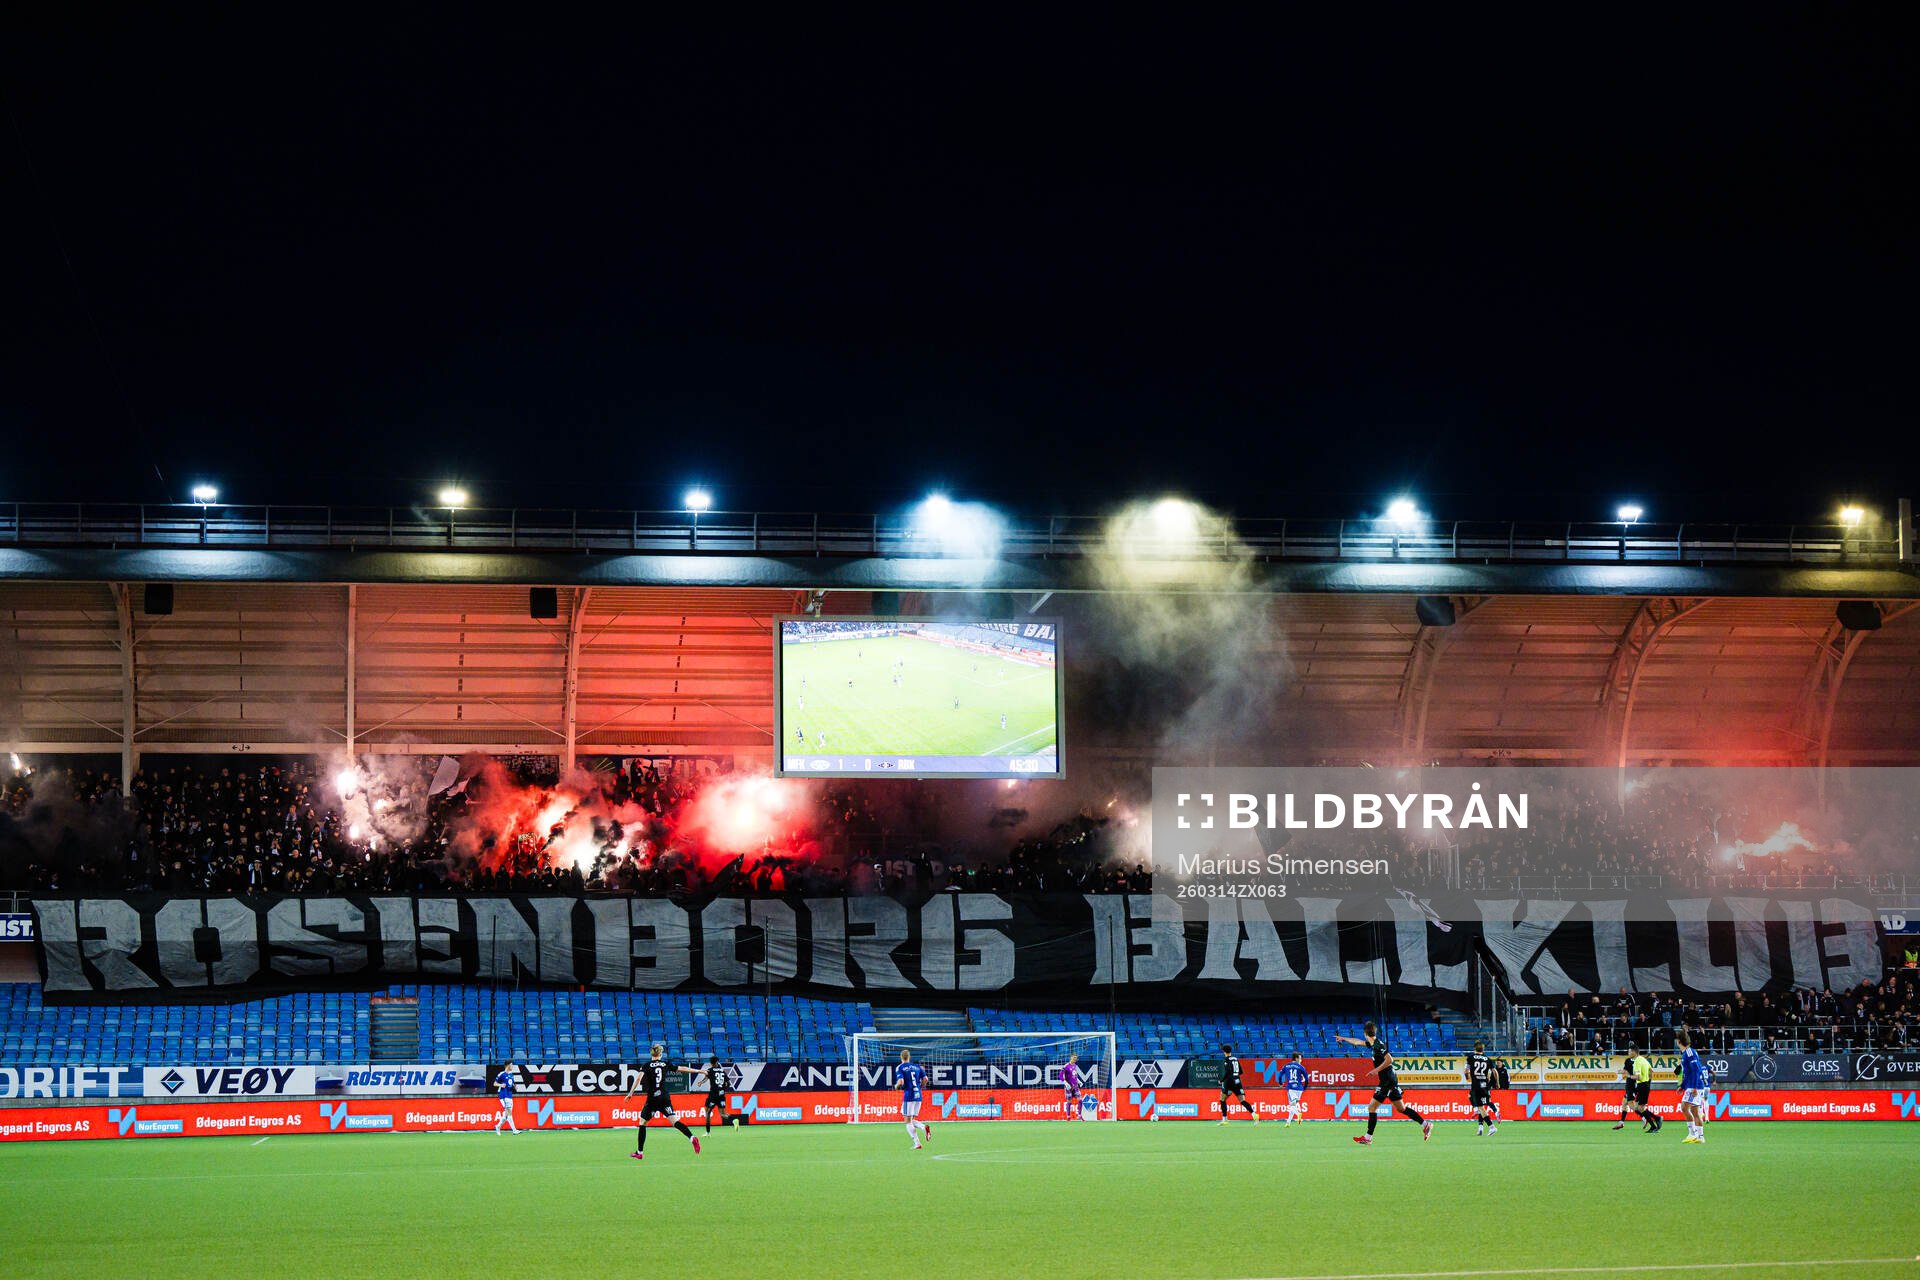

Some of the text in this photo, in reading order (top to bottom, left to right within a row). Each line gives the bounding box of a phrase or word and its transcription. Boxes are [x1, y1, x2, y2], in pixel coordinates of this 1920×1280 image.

[32, 894, 1016, 991] ROSENBORG
[1392, 1059, 1456, 1071] SMART
[1474, 1061, 1488, 1076] 22
[1548, 1058, 1612, 1070] SMART
[1802, 1060, 1840, 1072] GLASS
[195, 1067, 295, 1095] VEØY
[346, 1070, 457, 1086] ROSTEIN AS
[655, 1067, 663, 1083] 3
[714, 1072, 725, 1085] 35
[1289, 1069, 1298, 1080] 14
[864, 1103, 898, 1116] Engros
[1014, 1102, 1060, 1114] Ødegaard
[1098, 1101, 1112, 1112] AS
[1157, 1105, 1195, 1115] NorEngros
[1543, 1106, 1580, 1115] NorEngros
[1732, 1106, 1768, 1115] NorEngros
[1783, 1102, 1876, 1115] Ødegaard Engros AS
[406, 1111, 455, 1124] Ødegaard
[458, 1111, 492, 1124] Engros
[556, 1114, 596, 1123] NorEngros
[759, 1110, 798, 1119] NorEngros
[36, 1121, 71, 1134] Engros
[75, 1120, 90, 1132] AS
[138, 1122, 180, 1132] NorEngros
[196, 1114, 301, 1129] Ødegaard Engros AS
[349, 1117, 389, 1127] NorEngros
